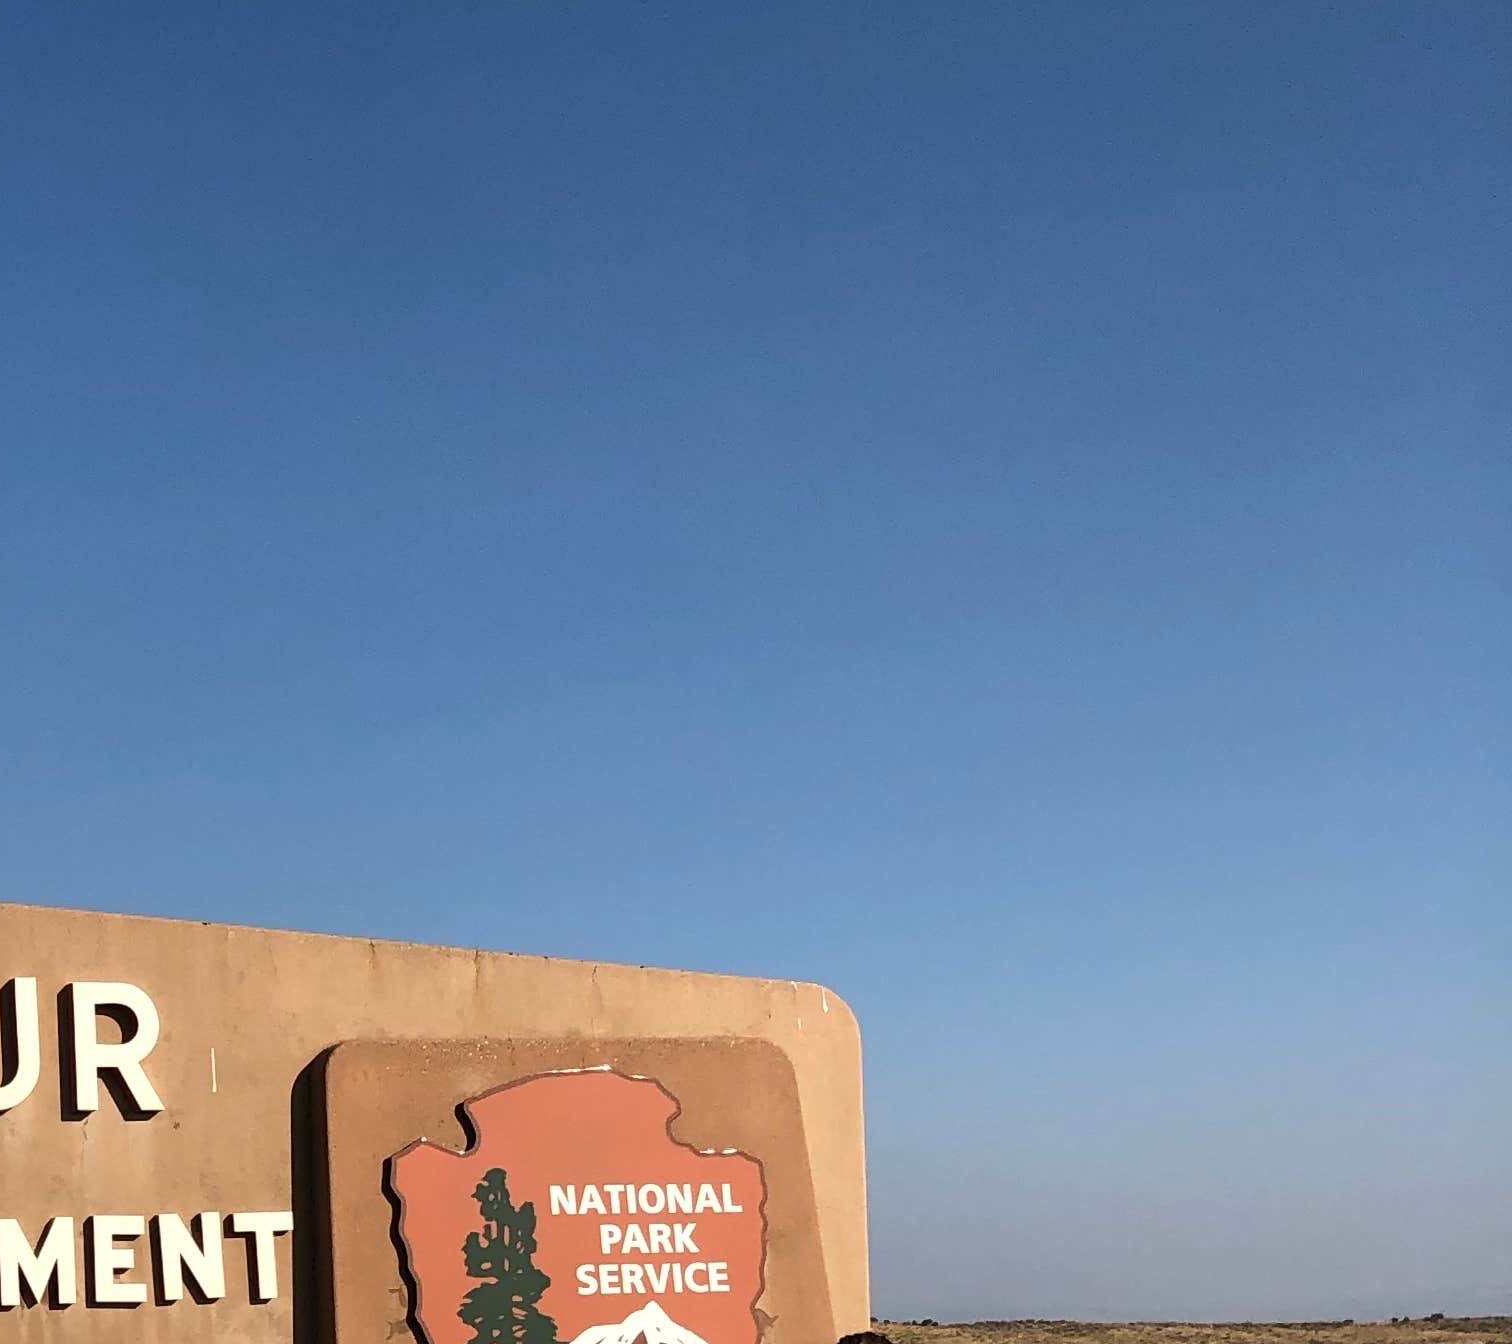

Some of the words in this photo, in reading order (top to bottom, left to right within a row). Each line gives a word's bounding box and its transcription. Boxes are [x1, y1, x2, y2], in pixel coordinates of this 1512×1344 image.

[548, 1182, 744, 1217] NATIONAL
[598, 1221, 701, 1256] PARK
[575, 1260, 732, 1297] SERVICE
